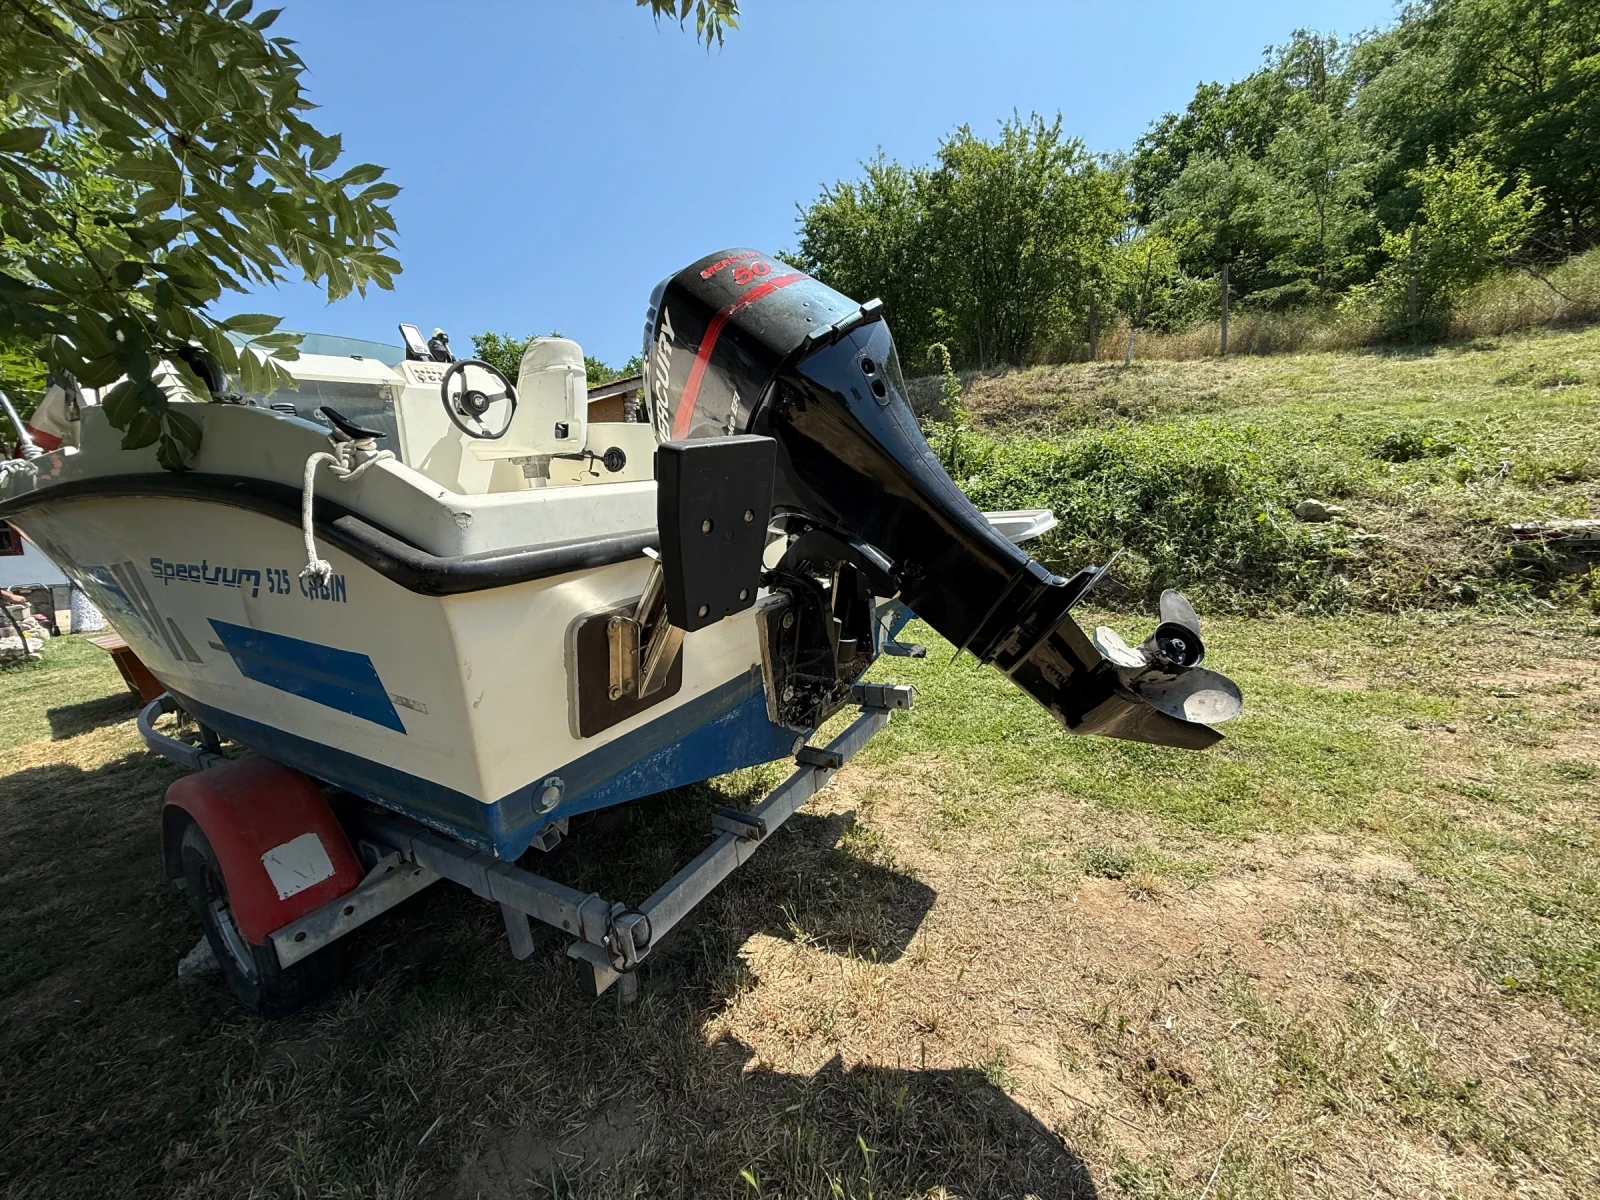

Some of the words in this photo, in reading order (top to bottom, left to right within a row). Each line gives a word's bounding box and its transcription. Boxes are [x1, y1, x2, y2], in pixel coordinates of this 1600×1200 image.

[700, 252, 760, 279] MERCURY
[732, 261, 771, 285] 50
[731, 390, 740, 416] EFI
[150, 557, 261, 598] Spectrum
[265, 567, 291, 595] 525
